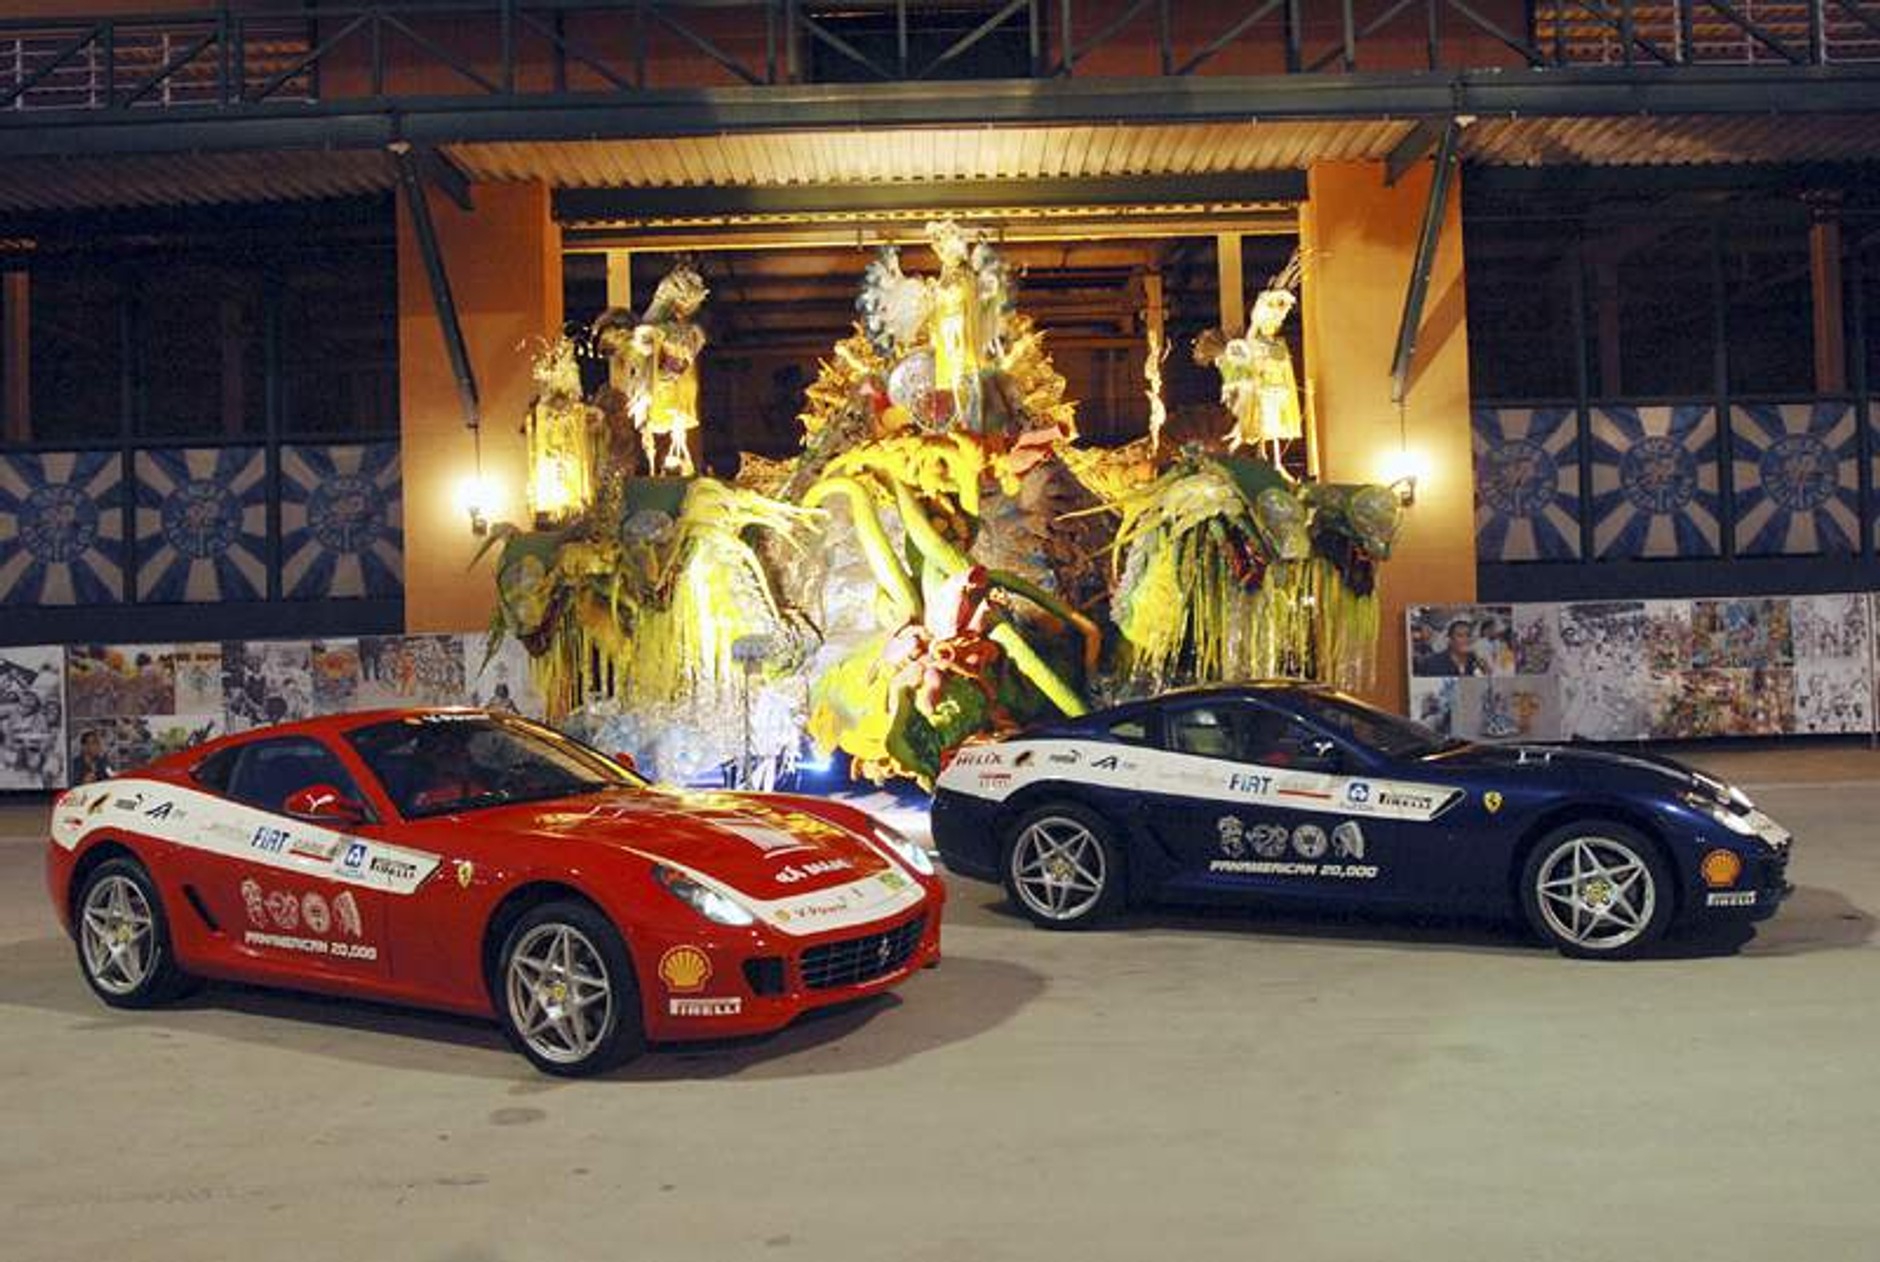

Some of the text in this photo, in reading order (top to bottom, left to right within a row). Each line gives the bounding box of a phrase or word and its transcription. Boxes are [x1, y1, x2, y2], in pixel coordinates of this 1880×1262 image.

[1229, 773, 1273, 795] FIAT
[1379, 792, 1432, 810] PIRELLI
[251, 826, 290, 852] FIAT
[1209, 860, 1379, 879] PANAMERICAN 20,000
[330, 941, 378, 961] 20,000
[669, 996, 742, 1016] PIRELLI
